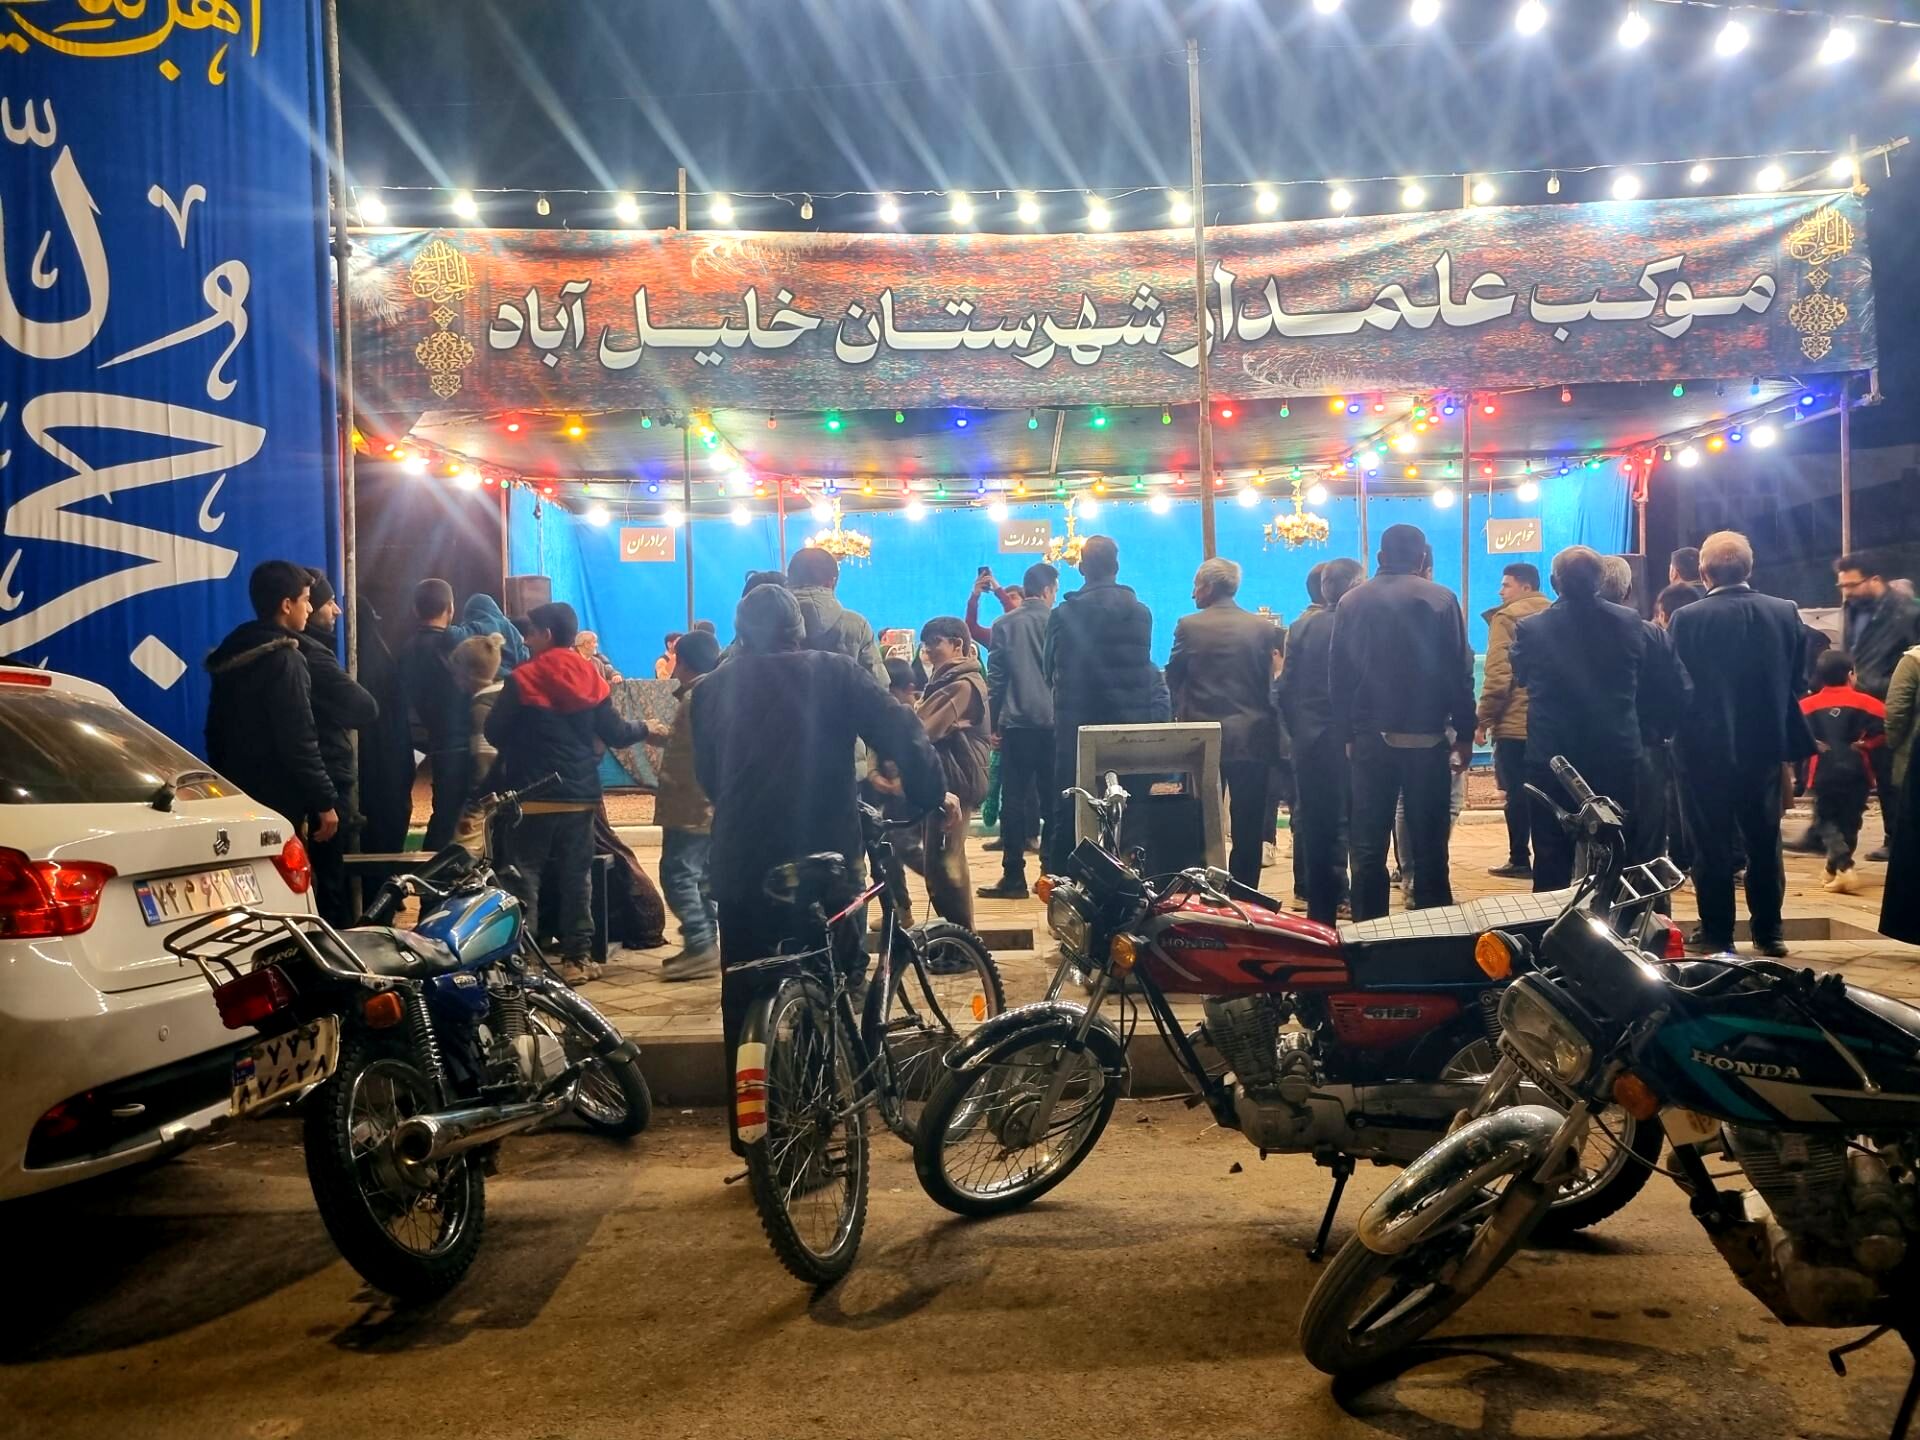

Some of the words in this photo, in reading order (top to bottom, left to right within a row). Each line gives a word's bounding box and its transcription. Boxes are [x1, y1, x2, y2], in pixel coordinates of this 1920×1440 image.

[489, 278, 591, 368] آباد
[600, 284, 824, 369] خلیل
[835, 282, 1168, 368] شهرستان
[1162, 250, 1517, 368] علمدار
[1530, 254, 1776, 343] موکب
[626, 533, 668, 556] برادران
[1004, 527, 1046, 547] نذورات
[1495, 522, 1535, 550] خواهران
[1507, 1042, 1568, 1105] HONDA
[1689, 1047, 1801, 1079] HONDA
